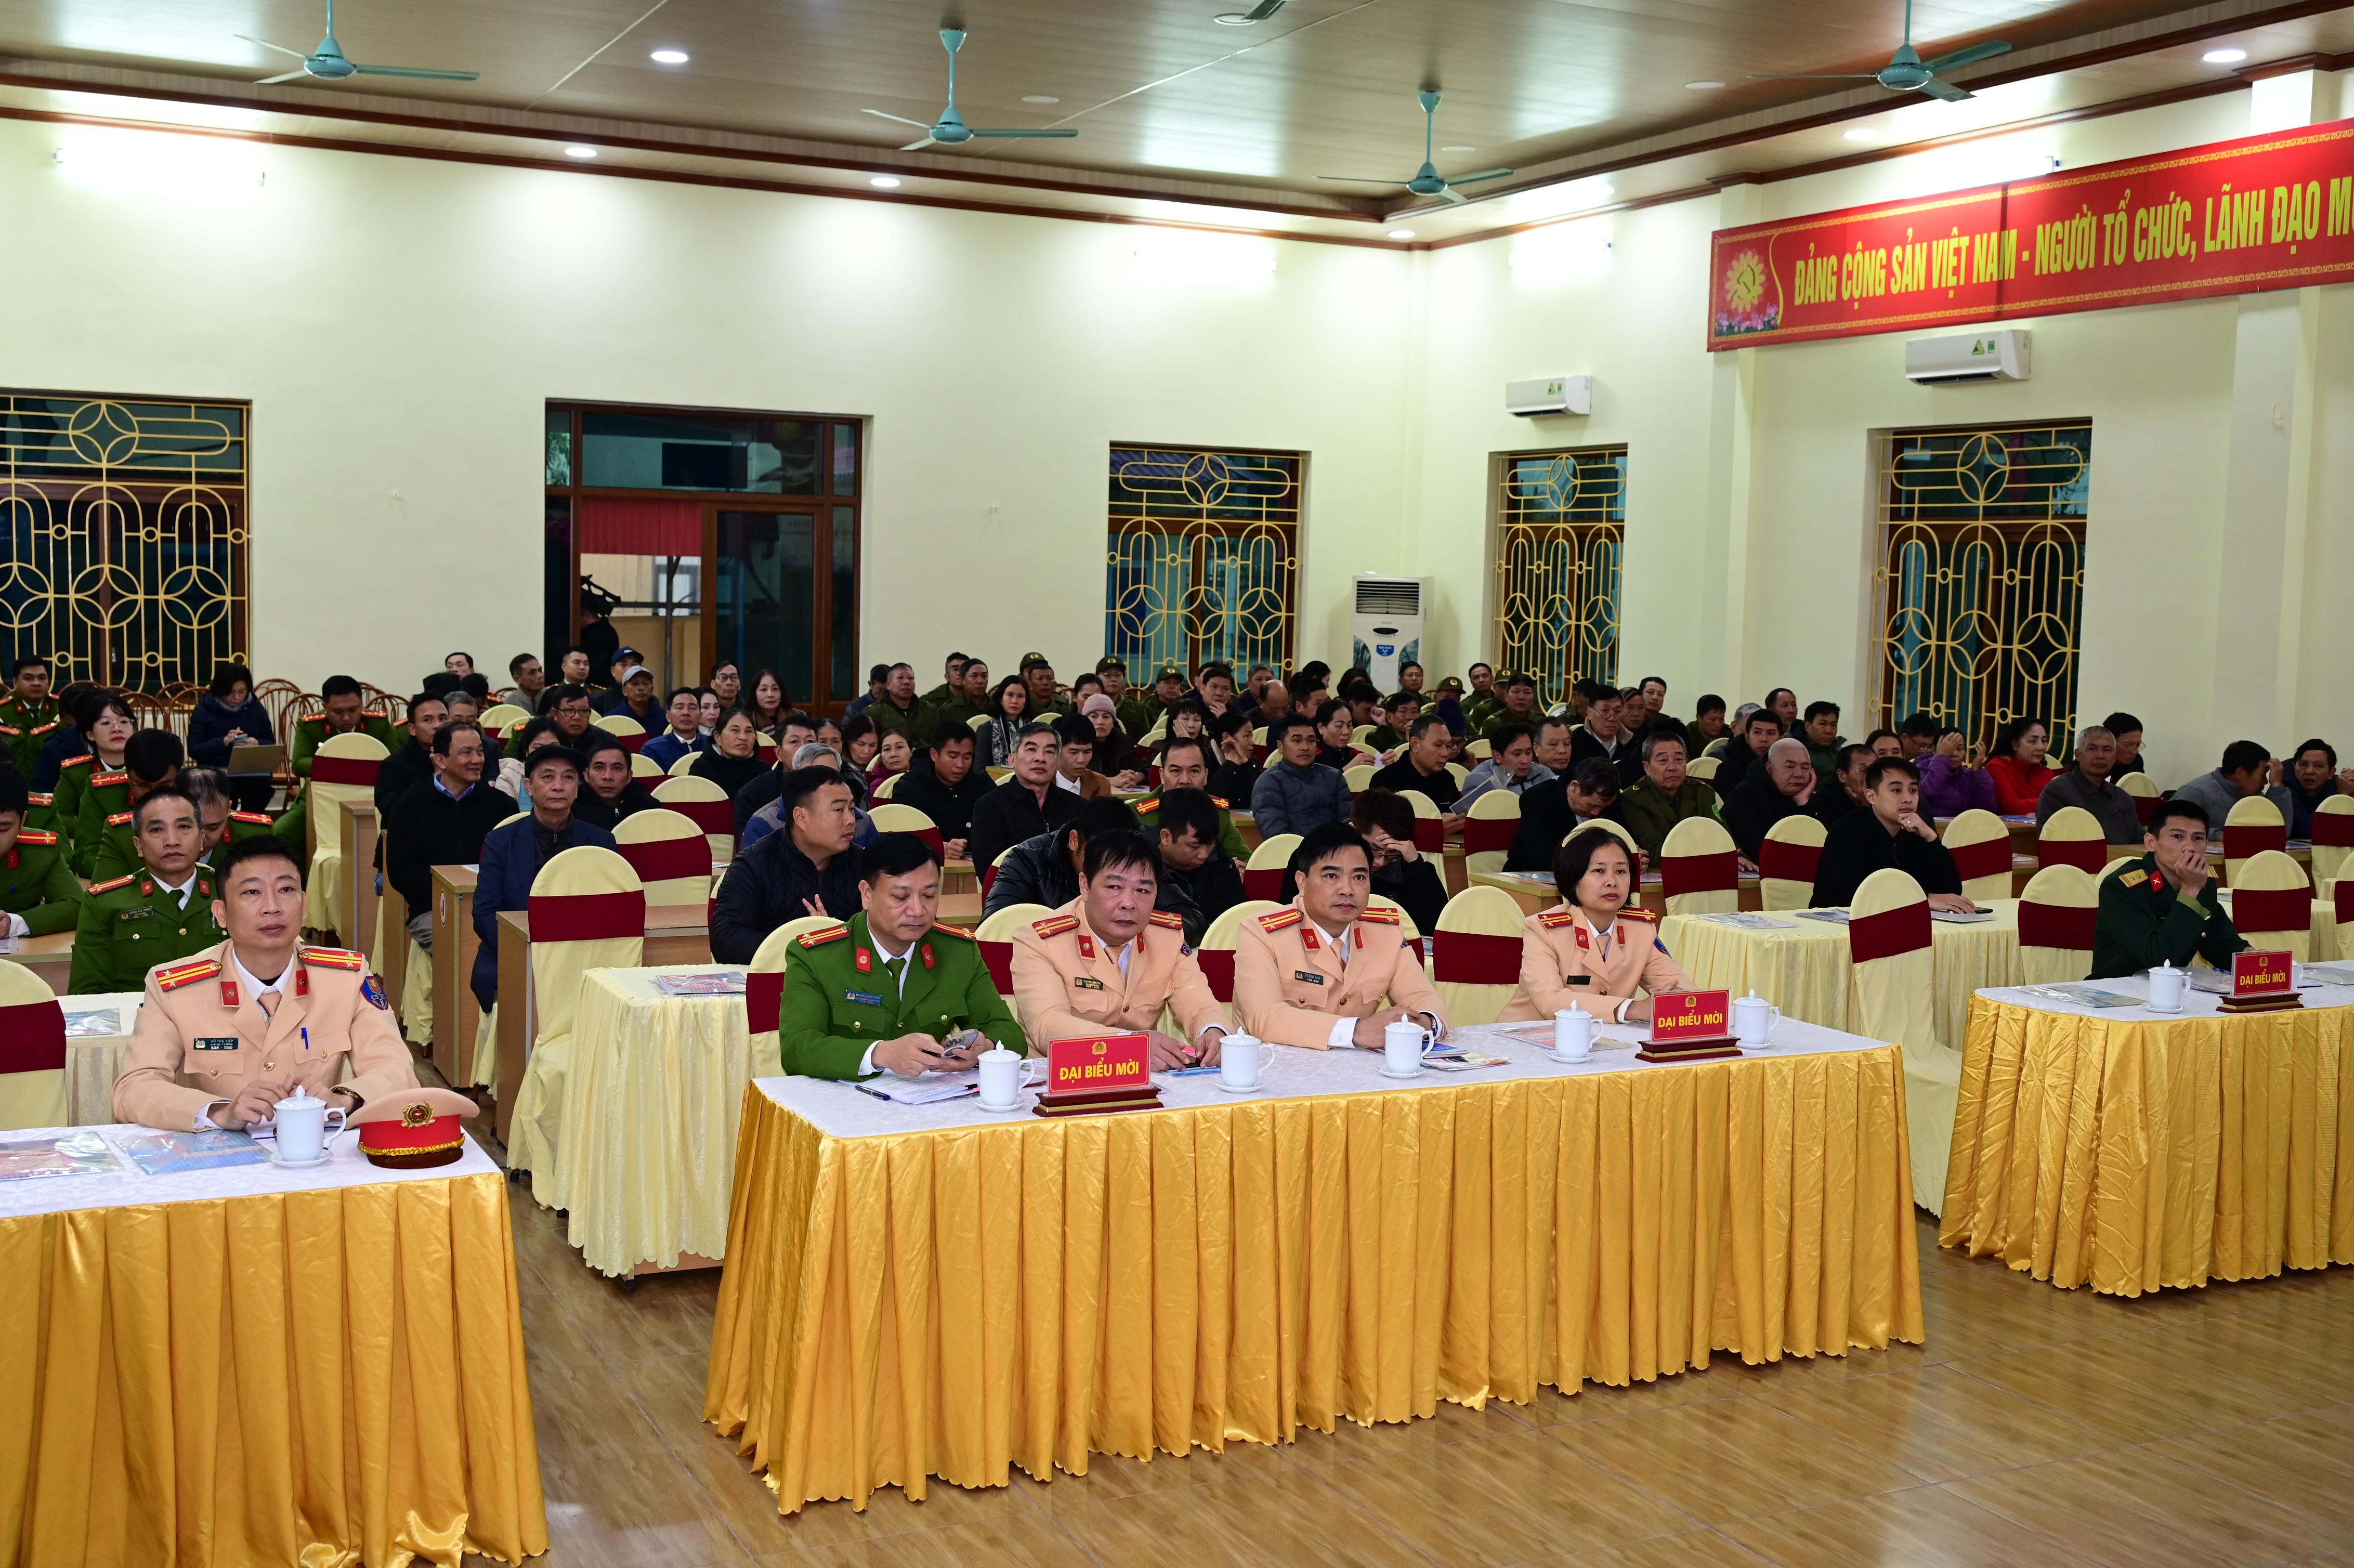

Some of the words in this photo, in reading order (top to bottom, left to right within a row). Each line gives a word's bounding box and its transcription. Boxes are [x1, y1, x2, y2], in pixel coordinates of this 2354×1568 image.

[1795, 243, 1838, 306] ĐẢNG
[1842, 241, 1887, 309] CỘNG
[1890, 227, 1927, 295] SẢN
[1932, 226, 1970, 298] VIỆT
[1973, 228, 2018, 284] NAM
[2035, 204, 2097, 276] NGƯỜI
[2103, 188, 2131, 266] TỔ
[2134, 191, 2196, 263] CHỨC,
[2204, 183, 2266, 252] LÃNH
[2270, 180, 2321, 255] ĐẠO
[2327, 176, 2354, 237] M
[2240, 975, 2253, 988] ĐẠI
[2254, 969, 2271, 984] BIỂU
[2272, 970, 2286, 983] MỜI
[1658, 1016, 1676, 1030] ĐẠI
[1679, 1009, 1702, 1026] BIỂU
[1704, 1011, 1723, 1024] MỜI
[1059, 1066, 1082, 1083] ĐẠI
[1085, 1057, 1113, 1078] BIỂU
[1116, 1059, 1140, 1076] MỜI
